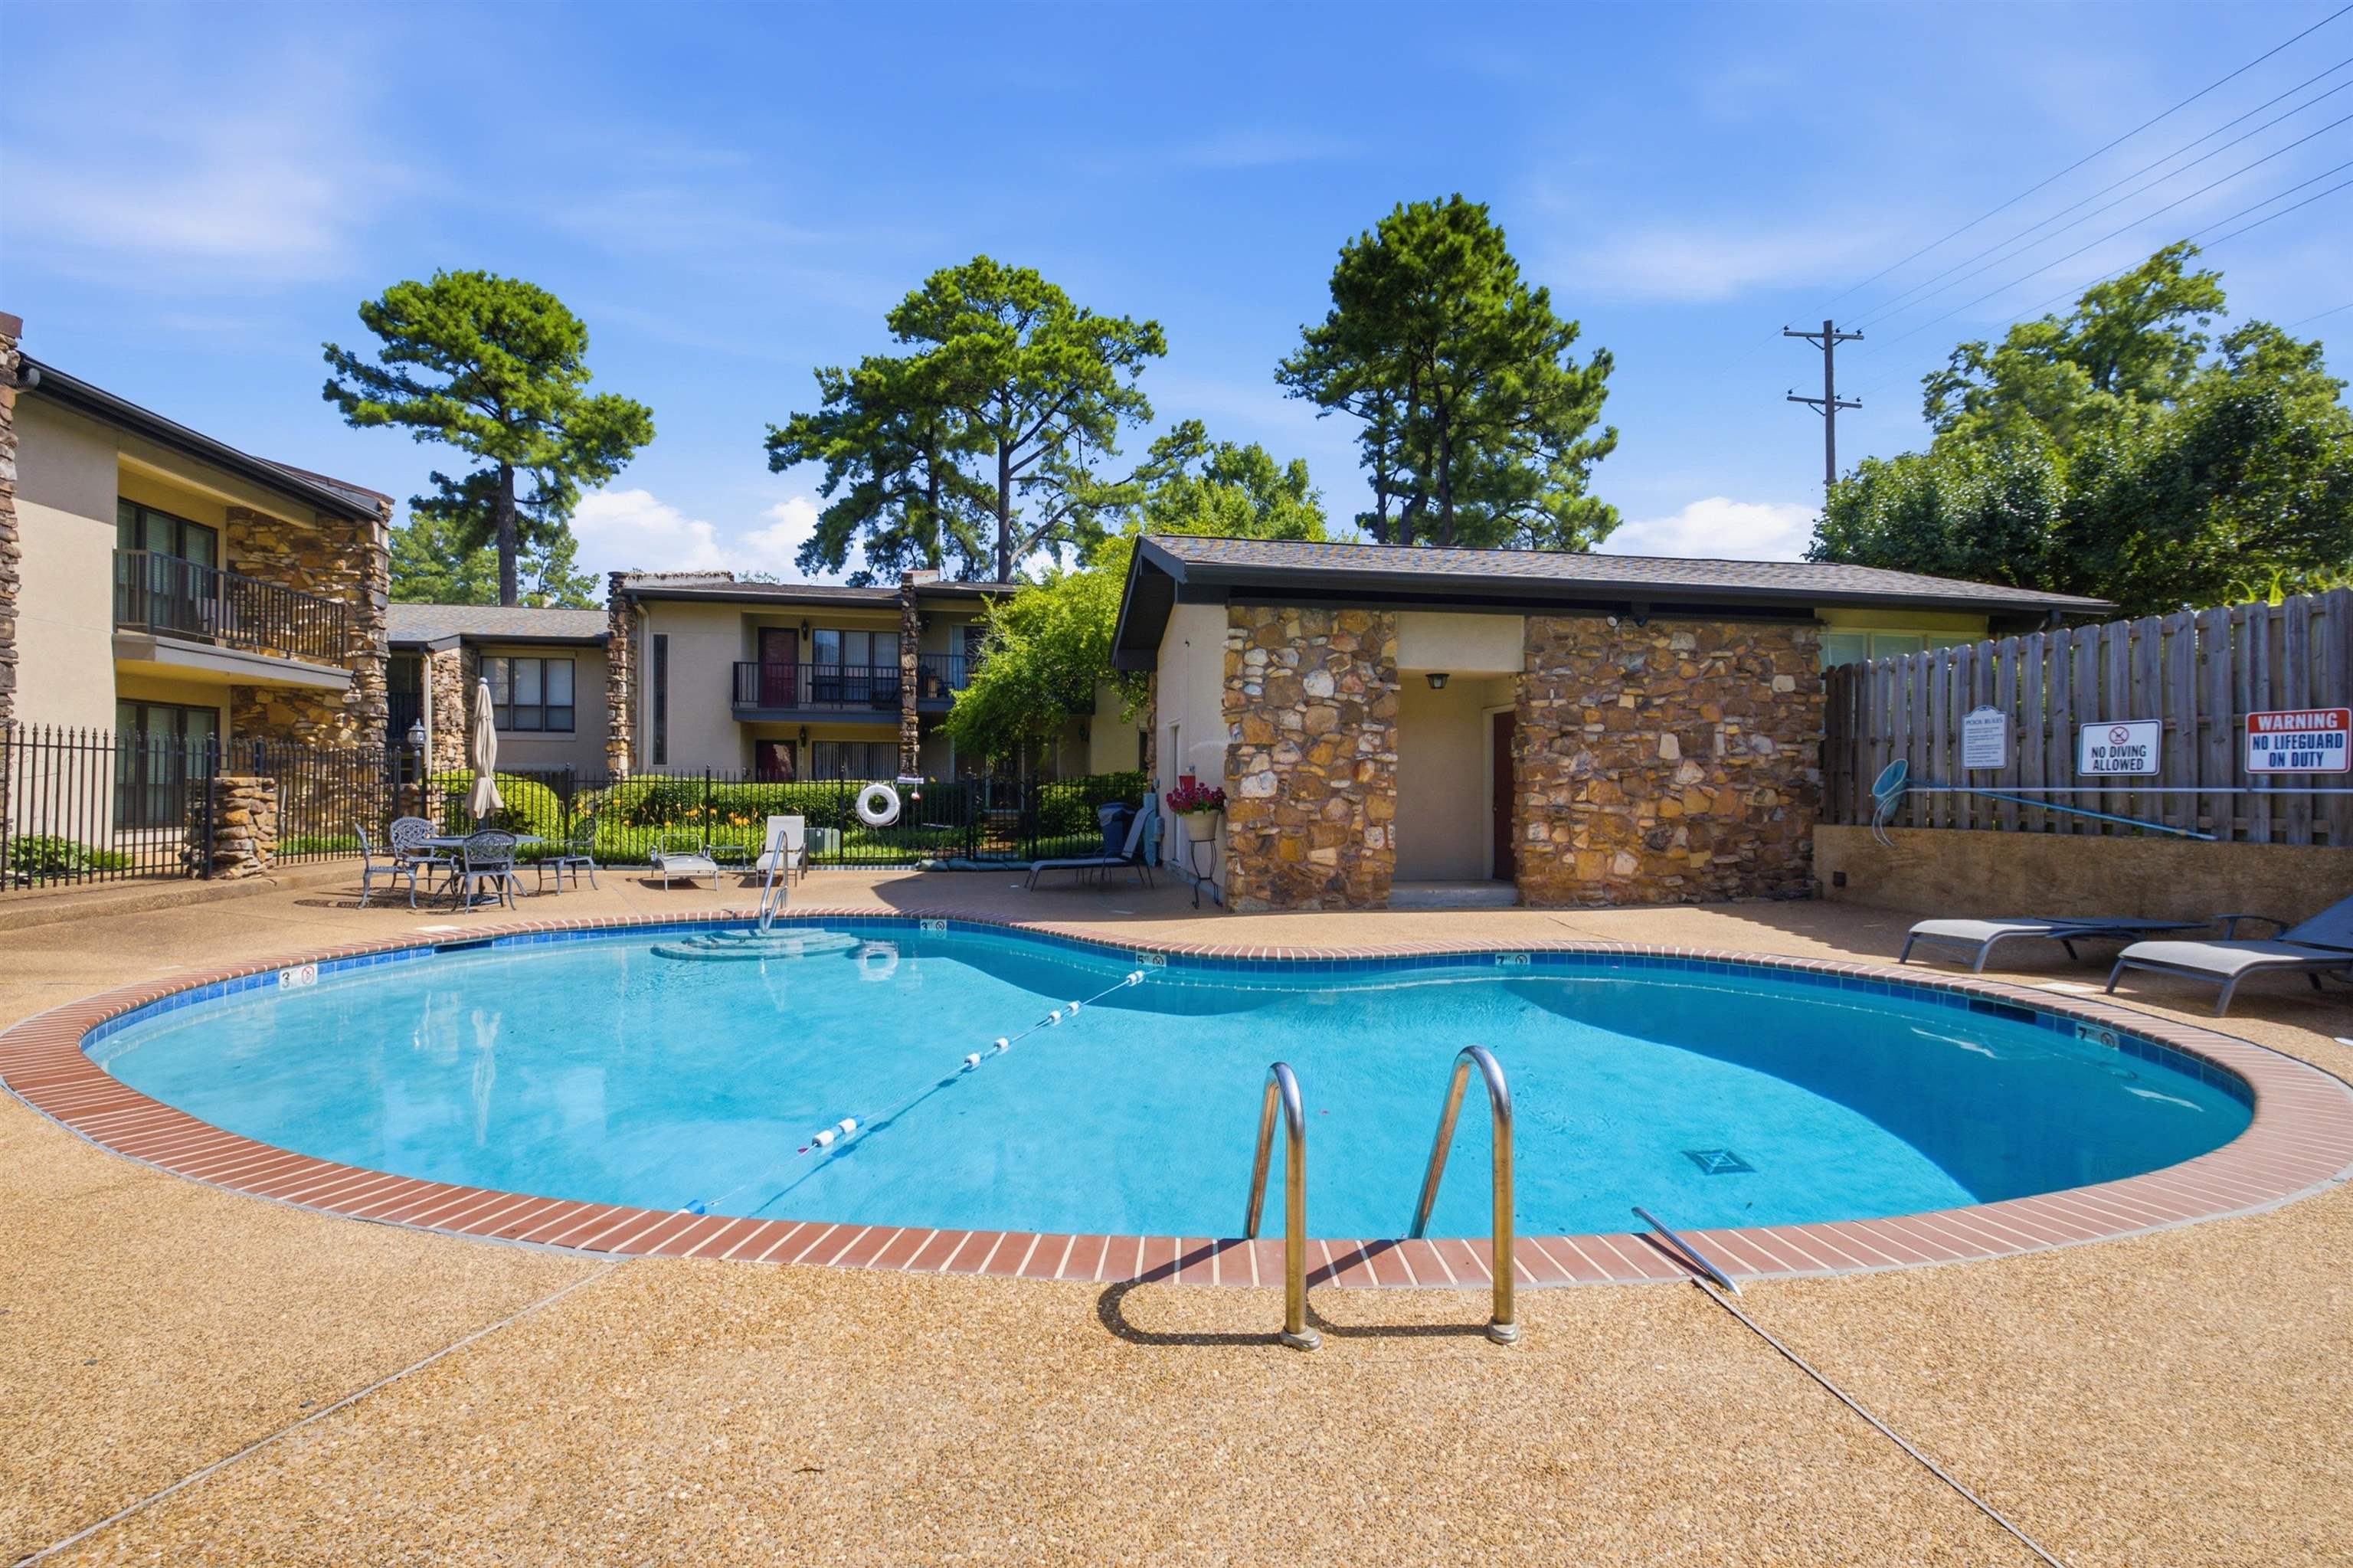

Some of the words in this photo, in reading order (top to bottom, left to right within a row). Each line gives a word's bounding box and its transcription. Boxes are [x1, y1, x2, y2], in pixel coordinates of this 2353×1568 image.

[2258, 712, 2338, 731] WARNING
[2253, 735, 2269, 750] NO
[2274, 733, 2343, 750] LIFEGUARD
[2091, 746, 2106, 758] NO
[2109, 745, 2146, 758] DIVING
[2269, 752, 2285, 767] ON
[2291, 751, 2324, 767] DUTY
[2093, 758, 2144, 771] ALLOWED
[282, 972, 290, 988] 3
